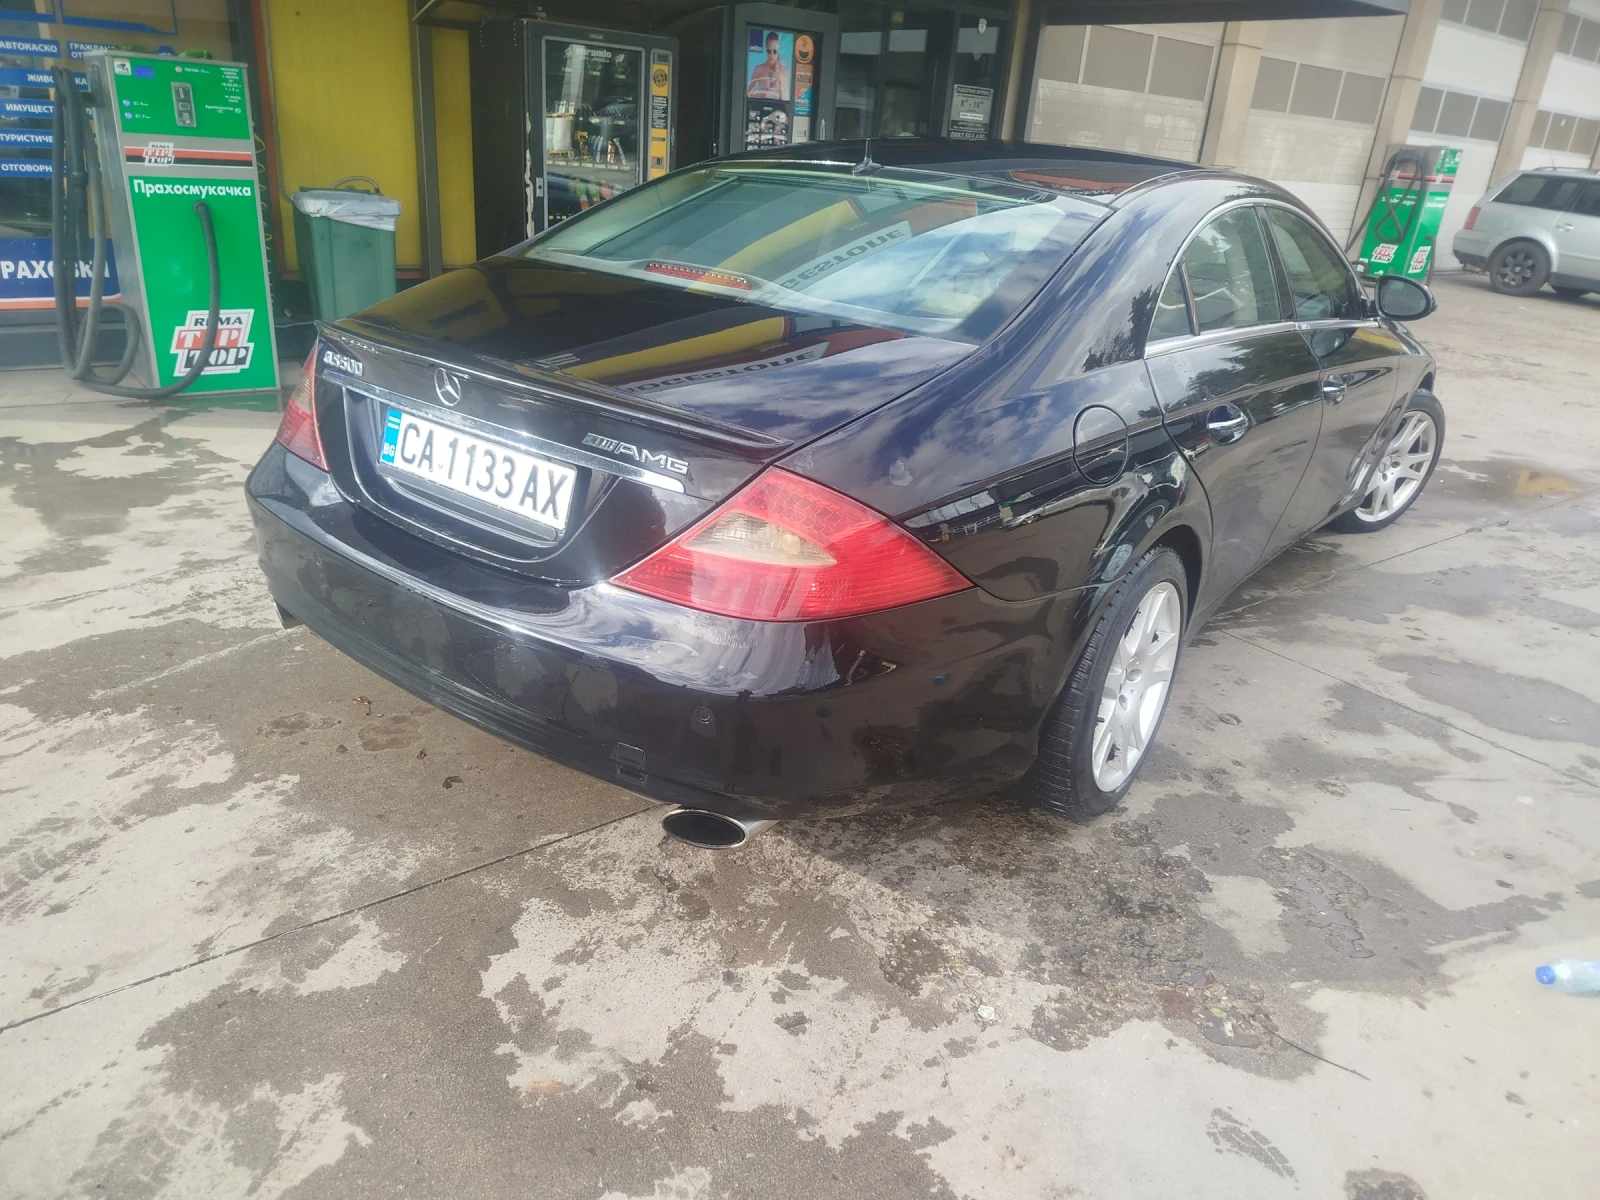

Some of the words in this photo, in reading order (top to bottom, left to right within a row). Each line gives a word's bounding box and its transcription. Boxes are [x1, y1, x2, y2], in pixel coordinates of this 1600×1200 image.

[0, 41, 57, 53] АВТОКАСКО
[150, 156, 172, 164] TOP
[133, 179, 251, 198] Прахосмукачка
[194, 316, 243, 327] RMA
[180, 329, 239, 348] TP
[383, 443, 396, 457] BG
[614, 441, 690, 475] AMG
[400, 422, 435, 473] CA
[447, 437, 516, 499] 1133
[519, 465, 568, 520] AX
